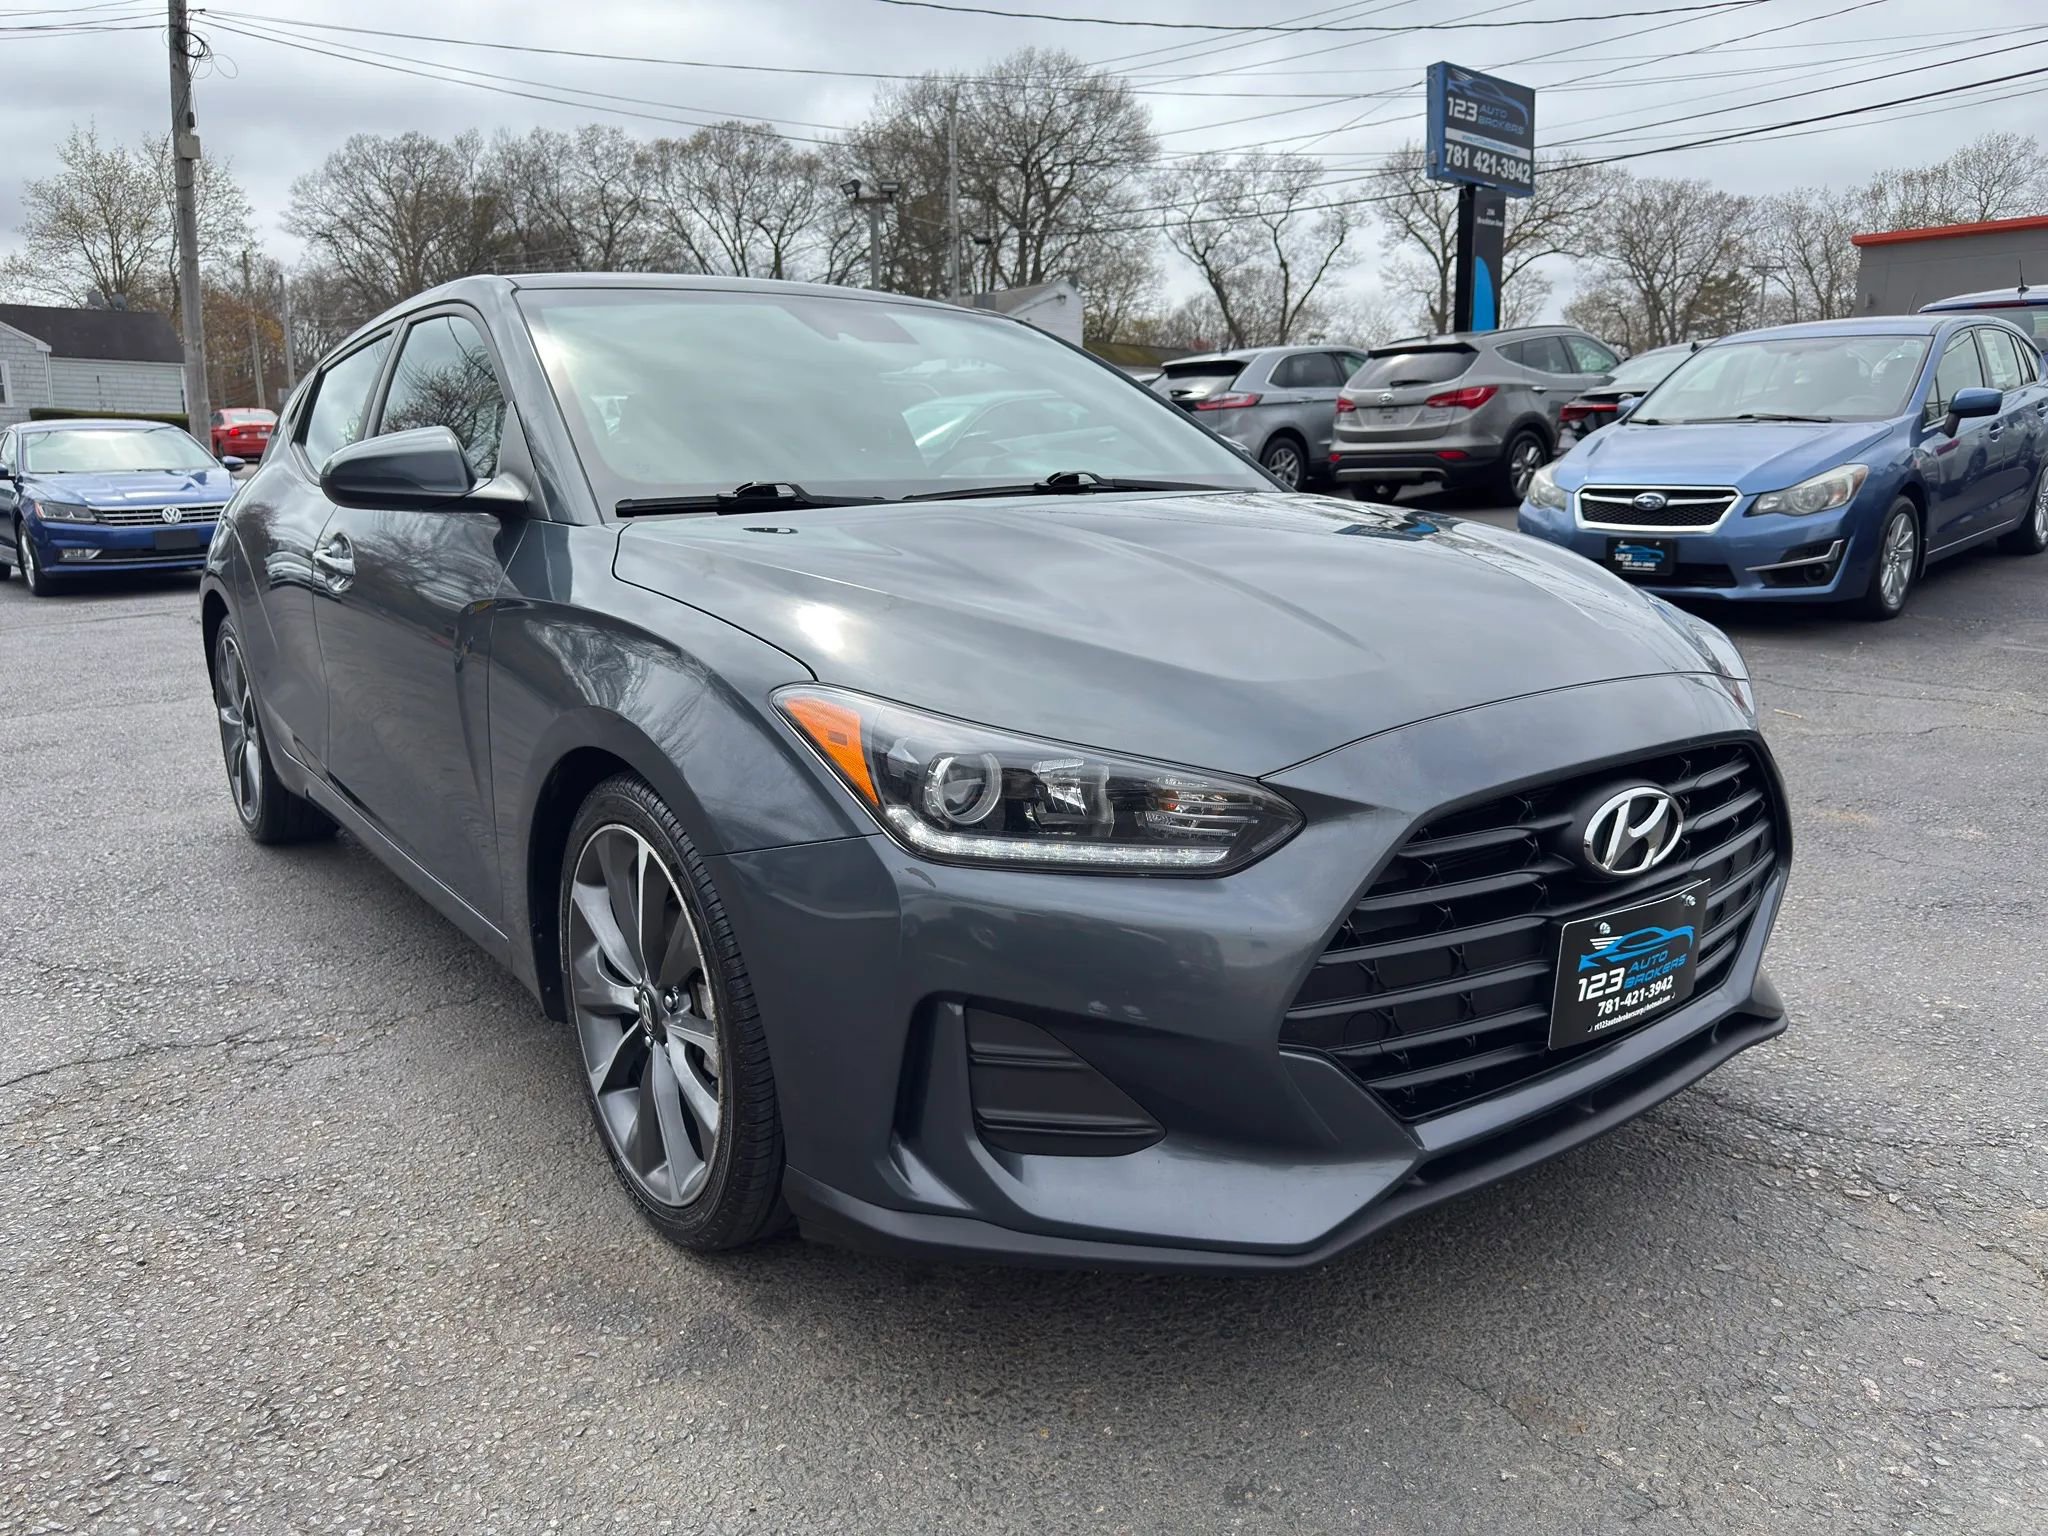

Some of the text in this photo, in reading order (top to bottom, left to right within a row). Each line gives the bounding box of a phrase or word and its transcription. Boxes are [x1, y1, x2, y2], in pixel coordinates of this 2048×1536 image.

[1447, 97, 1508, 122] 123 AUTO
[1477, 115, 1525, 135] BROKERS
[1444, 142, 1470, 169] 781
[1578, 950, 1669, 1002] 123 AUTO
[1623, 953, 1687, 990] BROKERS
[1597, 974, 1674, 1017] 781-421-3942
